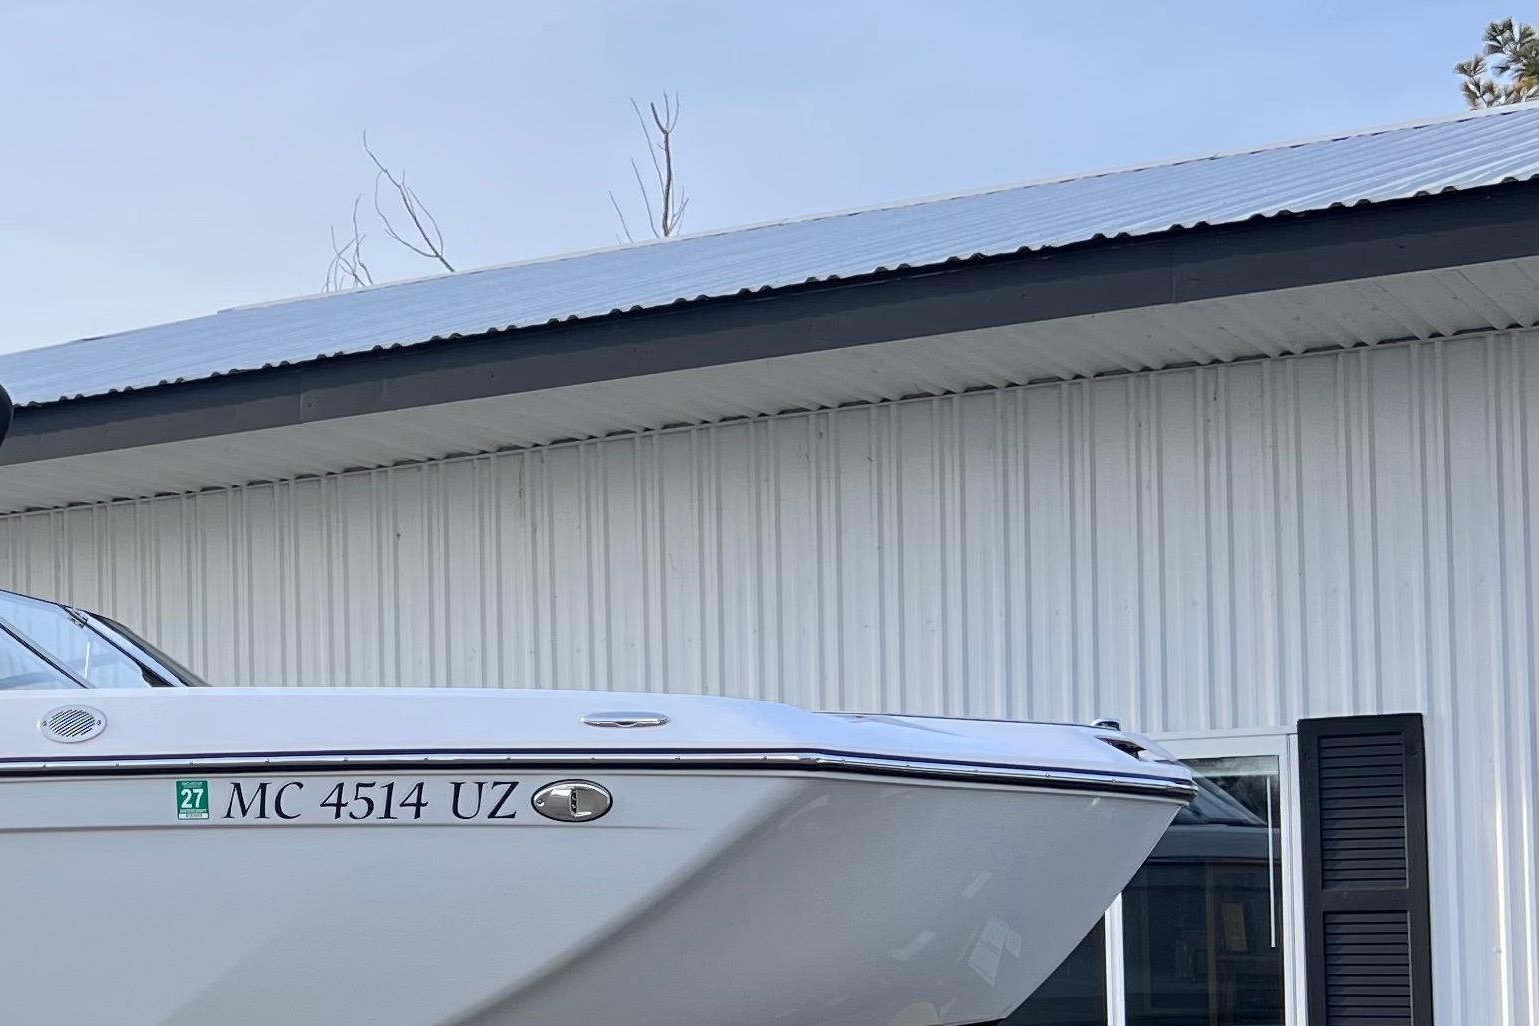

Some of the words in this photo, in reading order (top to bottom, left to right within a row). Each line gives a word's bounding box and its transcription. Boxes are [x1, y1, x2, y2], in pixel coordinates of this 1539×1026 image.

[181, 788, 204, 808] 27
[222, 781, 304, 819] MC
[319, 781, 429, 819] 4514
[450, 781, 519, 819] UZ
